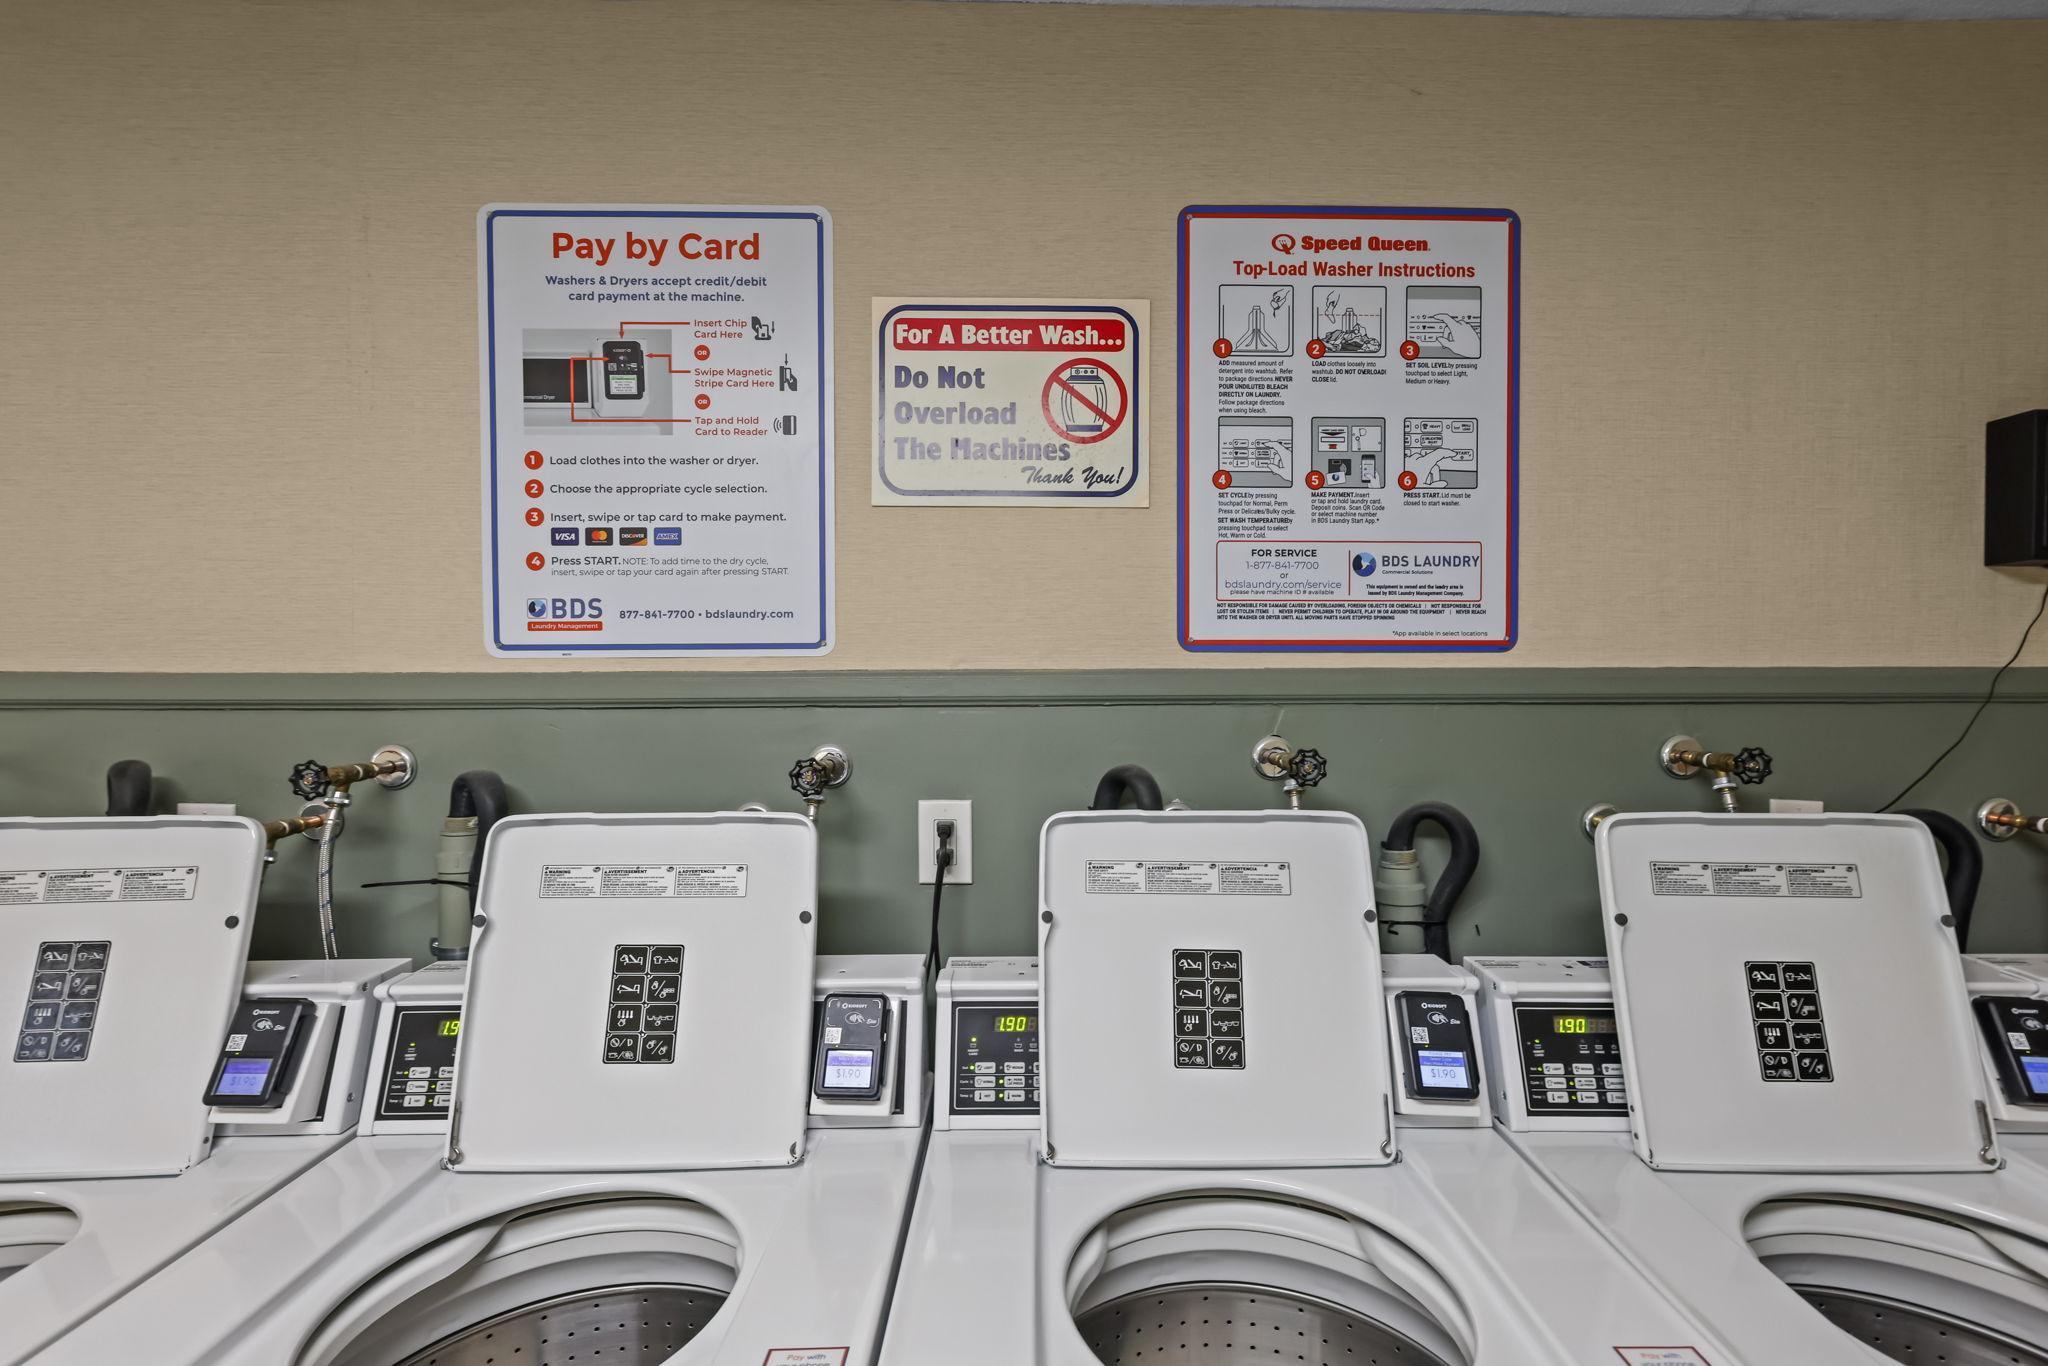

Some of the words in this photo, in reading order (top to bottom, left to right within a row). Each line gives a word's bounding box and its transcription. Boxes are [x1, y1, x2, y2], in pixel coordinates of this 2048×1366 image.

[553, 232, 615, 266] Pay
[626, 231, 668, 267] by
[678, 233, 759, 260] Card
[1301, 236, 1362, 252] Speed
[1368, 236, 1428, 251] Queen
[1233, 261, 1307, 279] Top-Load
[1313, 261, 1373, 277] Washer
[1379, 262, 1475, 278] Instructions
[545, 275, 595, 285] Washers
[599, 276, 606, 285] &
[610, 276, 648, 288] Dryers
[651, 277, 692, 288] accept
[695, 276, 767, 287] credit/debit
[568, 291, 594, 301] card
[598, 292, 650, 303] payment
[653, 292, 665, 301] at
[668, 292, 688, 301] the
[691, 292, 744, 302] machine.
[694, 319, 722, 327] Insert
[725, 319, 747, 329] Chip
[694, 330, 717, 339] Card
[719, 331, 743, 339] Here
[896, 324, 932, 344] For
[939, 324, 955, 344] A
[962, 325, 1032, 345] Better
[1039, 325, 1122, 345] Wash...
[1220, 344, 1225, 353] 1
[1312, 344, 1319, 354] 2
[1407, 346, 1413, 355] 3
[694, 368, 724, 377] Swipe
[727, 368, 772, 378] Magnetic
[895, 365, 929, 388] Do
[938, 365, 985, 388] Not
[694, 379, 723, 389] Stripe
[726, 379, 749, 387] Card
[894, 401, 1017, 425] Overload
[695, 417, 713, 426] Tap
[737, 416, 759, 426] Hold
[695, 427, 718, 436] Card
[732, 427, 768, 436] Reader
[895, 437, 942, 461] The
[951, 437, 1071, 461] Machines
[530, 455, 535, 464] 1
[550, 456, 577, 465] Load
[580, 456, 620, 465] clothes
[623, 455, 645, 465] into
[648, 456, 667, 465] the
[669, 456, 710, 465] washer
[727, 456, 759, 467] dryer.
[1021, 466, 1074, 484] Thank
[1082, 466, 1124, 490] You!
[1218, 475, 1226, 484] 4
[1310, 475, 1318, 485] 5
[1404, 476, 1411, 485] 6
[531, 484, 538, 493] 2
[550, 484, 591, 493] Choose
[594, 484, 613, 493] the
[616, 484, 681, 495] appropriate
[684, 484, 712, 495] cycle
[715, 484, 767, 493] selection.
[531, 512, 538, 521] 3
[551, 513, 585, 523] Insert,
[588, 512, 620, 523] swipe
[637, 514, 656, 523] tap
[659, 513, 683, 521] card
[686, 513, 698, 521] to
[701, 512, 732, 521] make
[735, 513, 786, 523] payment.
[555, 532, 575, 540] VISA
[656, 532, 680, 541] AMEX
[1251, 548, 1272, 557] FOR
[1275, 548, 1317, 558] SERVICE
[532, 556, 541, 567] 4
[552, 556, 582, 565] Press
[584, 556, 621, 565] START.
[622, 557, 649, 565] NOTE:
[650, 557, 660, 565] To
[662, 558, 679, 567] add
[713, 557, 728, 565] the
[729, 557, 744, 566] dry
[745, 557, 768, 567] cycle,
[1246, 561, 1320, 570] 1-877-841-7700
[1382, 555, 1409, 568] BDS
[1414, 555, 1480, 568] LAUNDRY
[579, 568, 604, 577] swipe
[616, 569, 632, 577] tap
[633, 569, 652, 577] your
[654, 568, 673, 576] card
[675, 569, 699, 577] again
[701, 567, 721, 575] after
[723, 568, 759, 577] pressing
[1224, 579, 1342, 591] bdslaundry.com/service
[551, 597, 603, 619] BDS
[619, 610, 695, 619] 877-841-7700
[705, 609, 793, 620] bdslaundry.com
[1000, 1017, 1026, 1031] 1.90
[1560, 1019, 1585, 1033] 1.90
[836, 1069, 861, 1078] $1.90
[1431, 1069, 1456, 1079] $1.90
